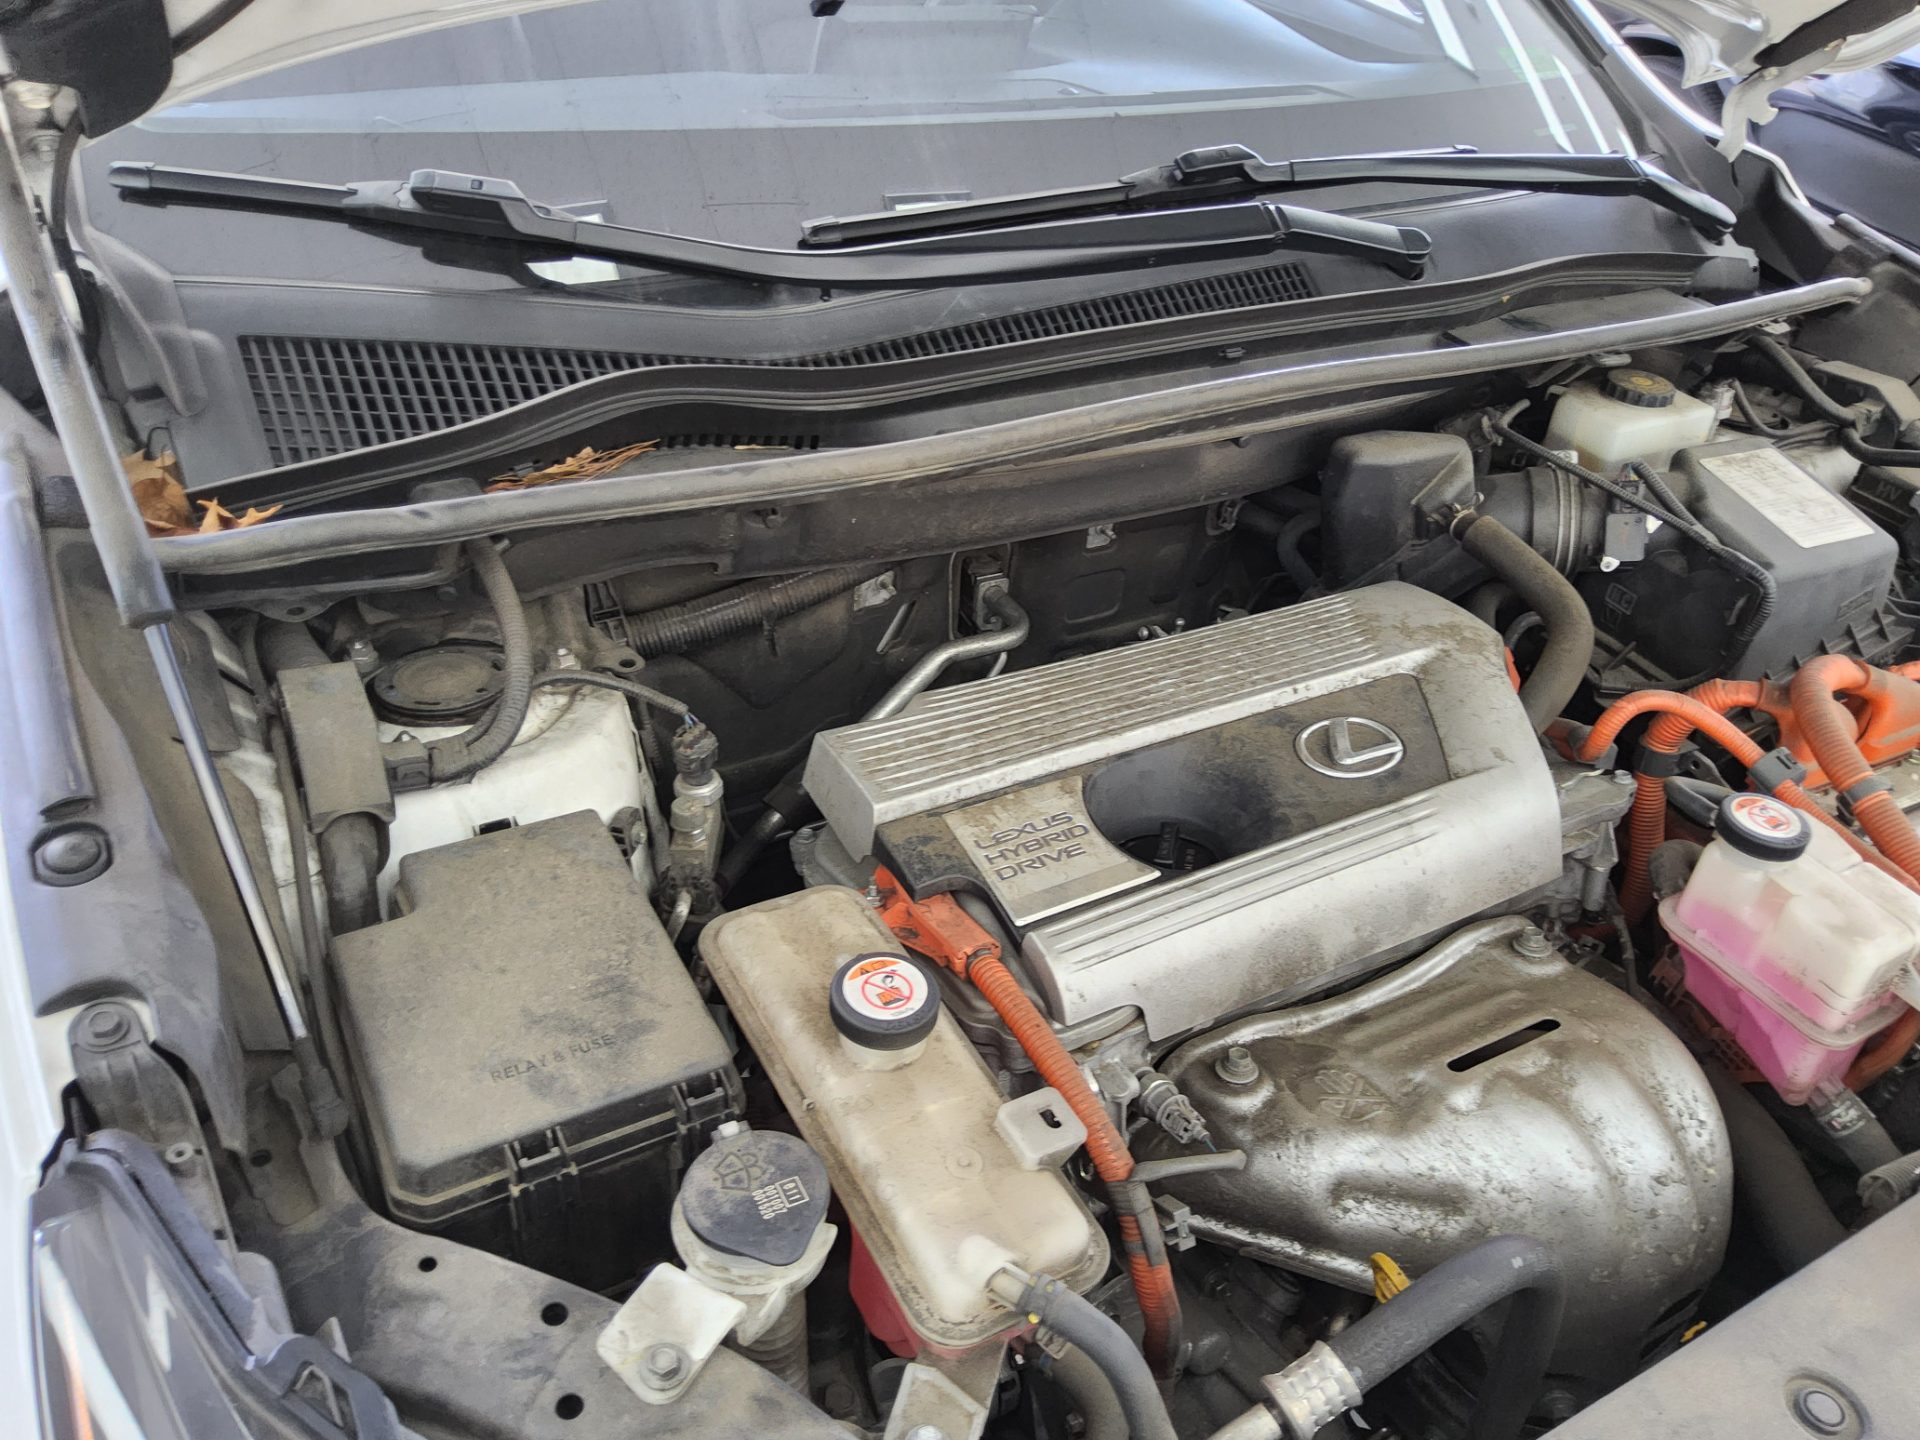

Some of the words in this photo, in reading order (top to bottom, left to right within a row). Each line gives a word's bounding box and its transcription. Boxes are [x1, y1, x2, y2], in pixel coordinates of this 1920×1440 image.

[973, 811, 1074, 849] LEXUS
[983, 824, 1090, 865] HYBRID
[994, 842, 1087, 881] DRIVE
[490, 1054, 548, 1082] RELAY
[553, 1050, 566, 1063] &
[568, 1034, 616, 1057] FUSE
